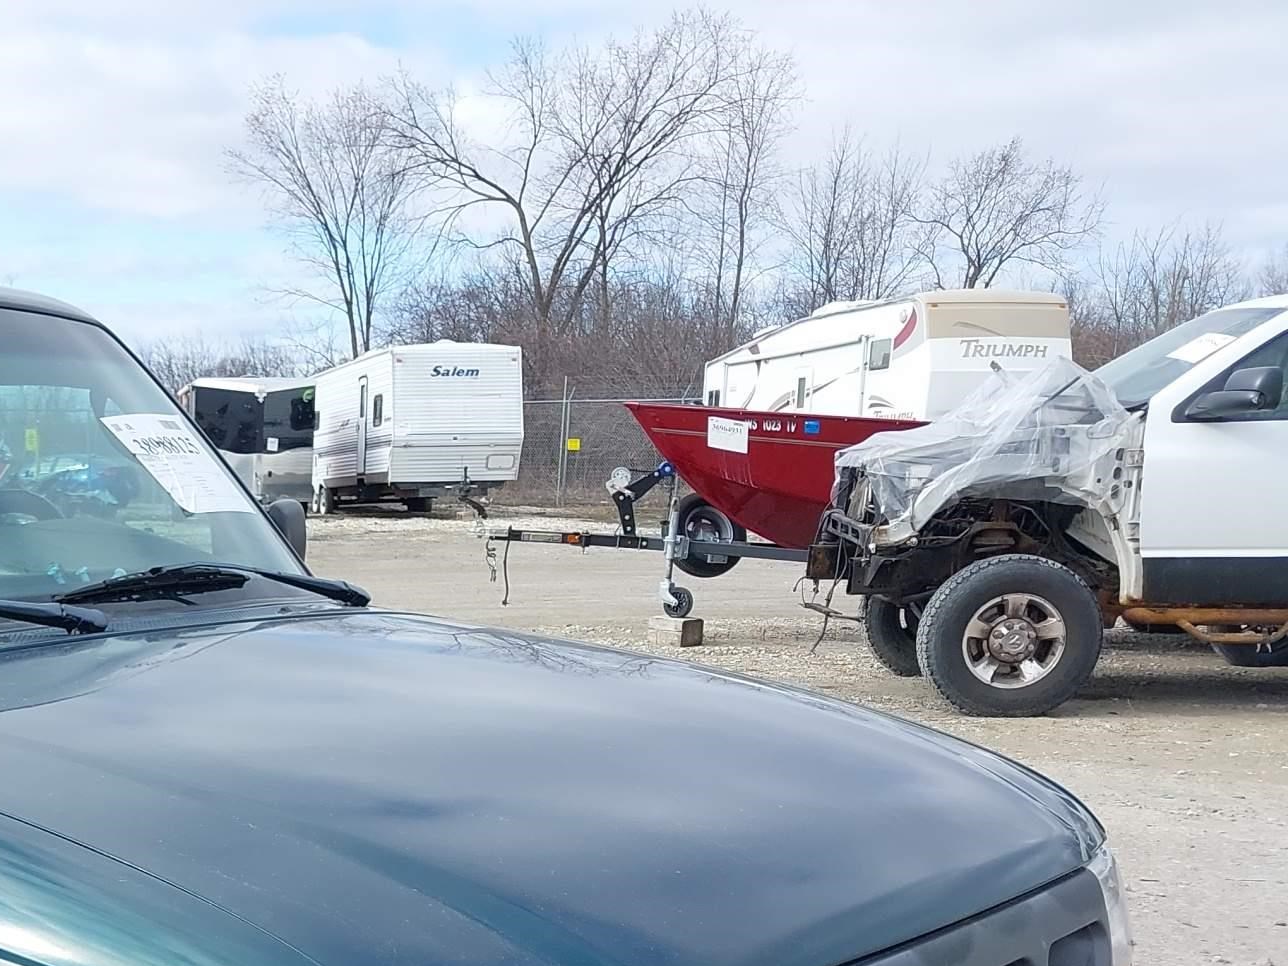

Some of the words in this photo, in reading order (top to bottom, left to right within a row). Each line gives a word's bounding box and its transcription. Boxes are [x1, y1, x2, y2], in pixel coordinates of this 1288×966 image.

[960, 339, 1048, 358] TRIUMPH
[430, 365, 480, 378] Salem
[762, 419, 782, 432] 1023
